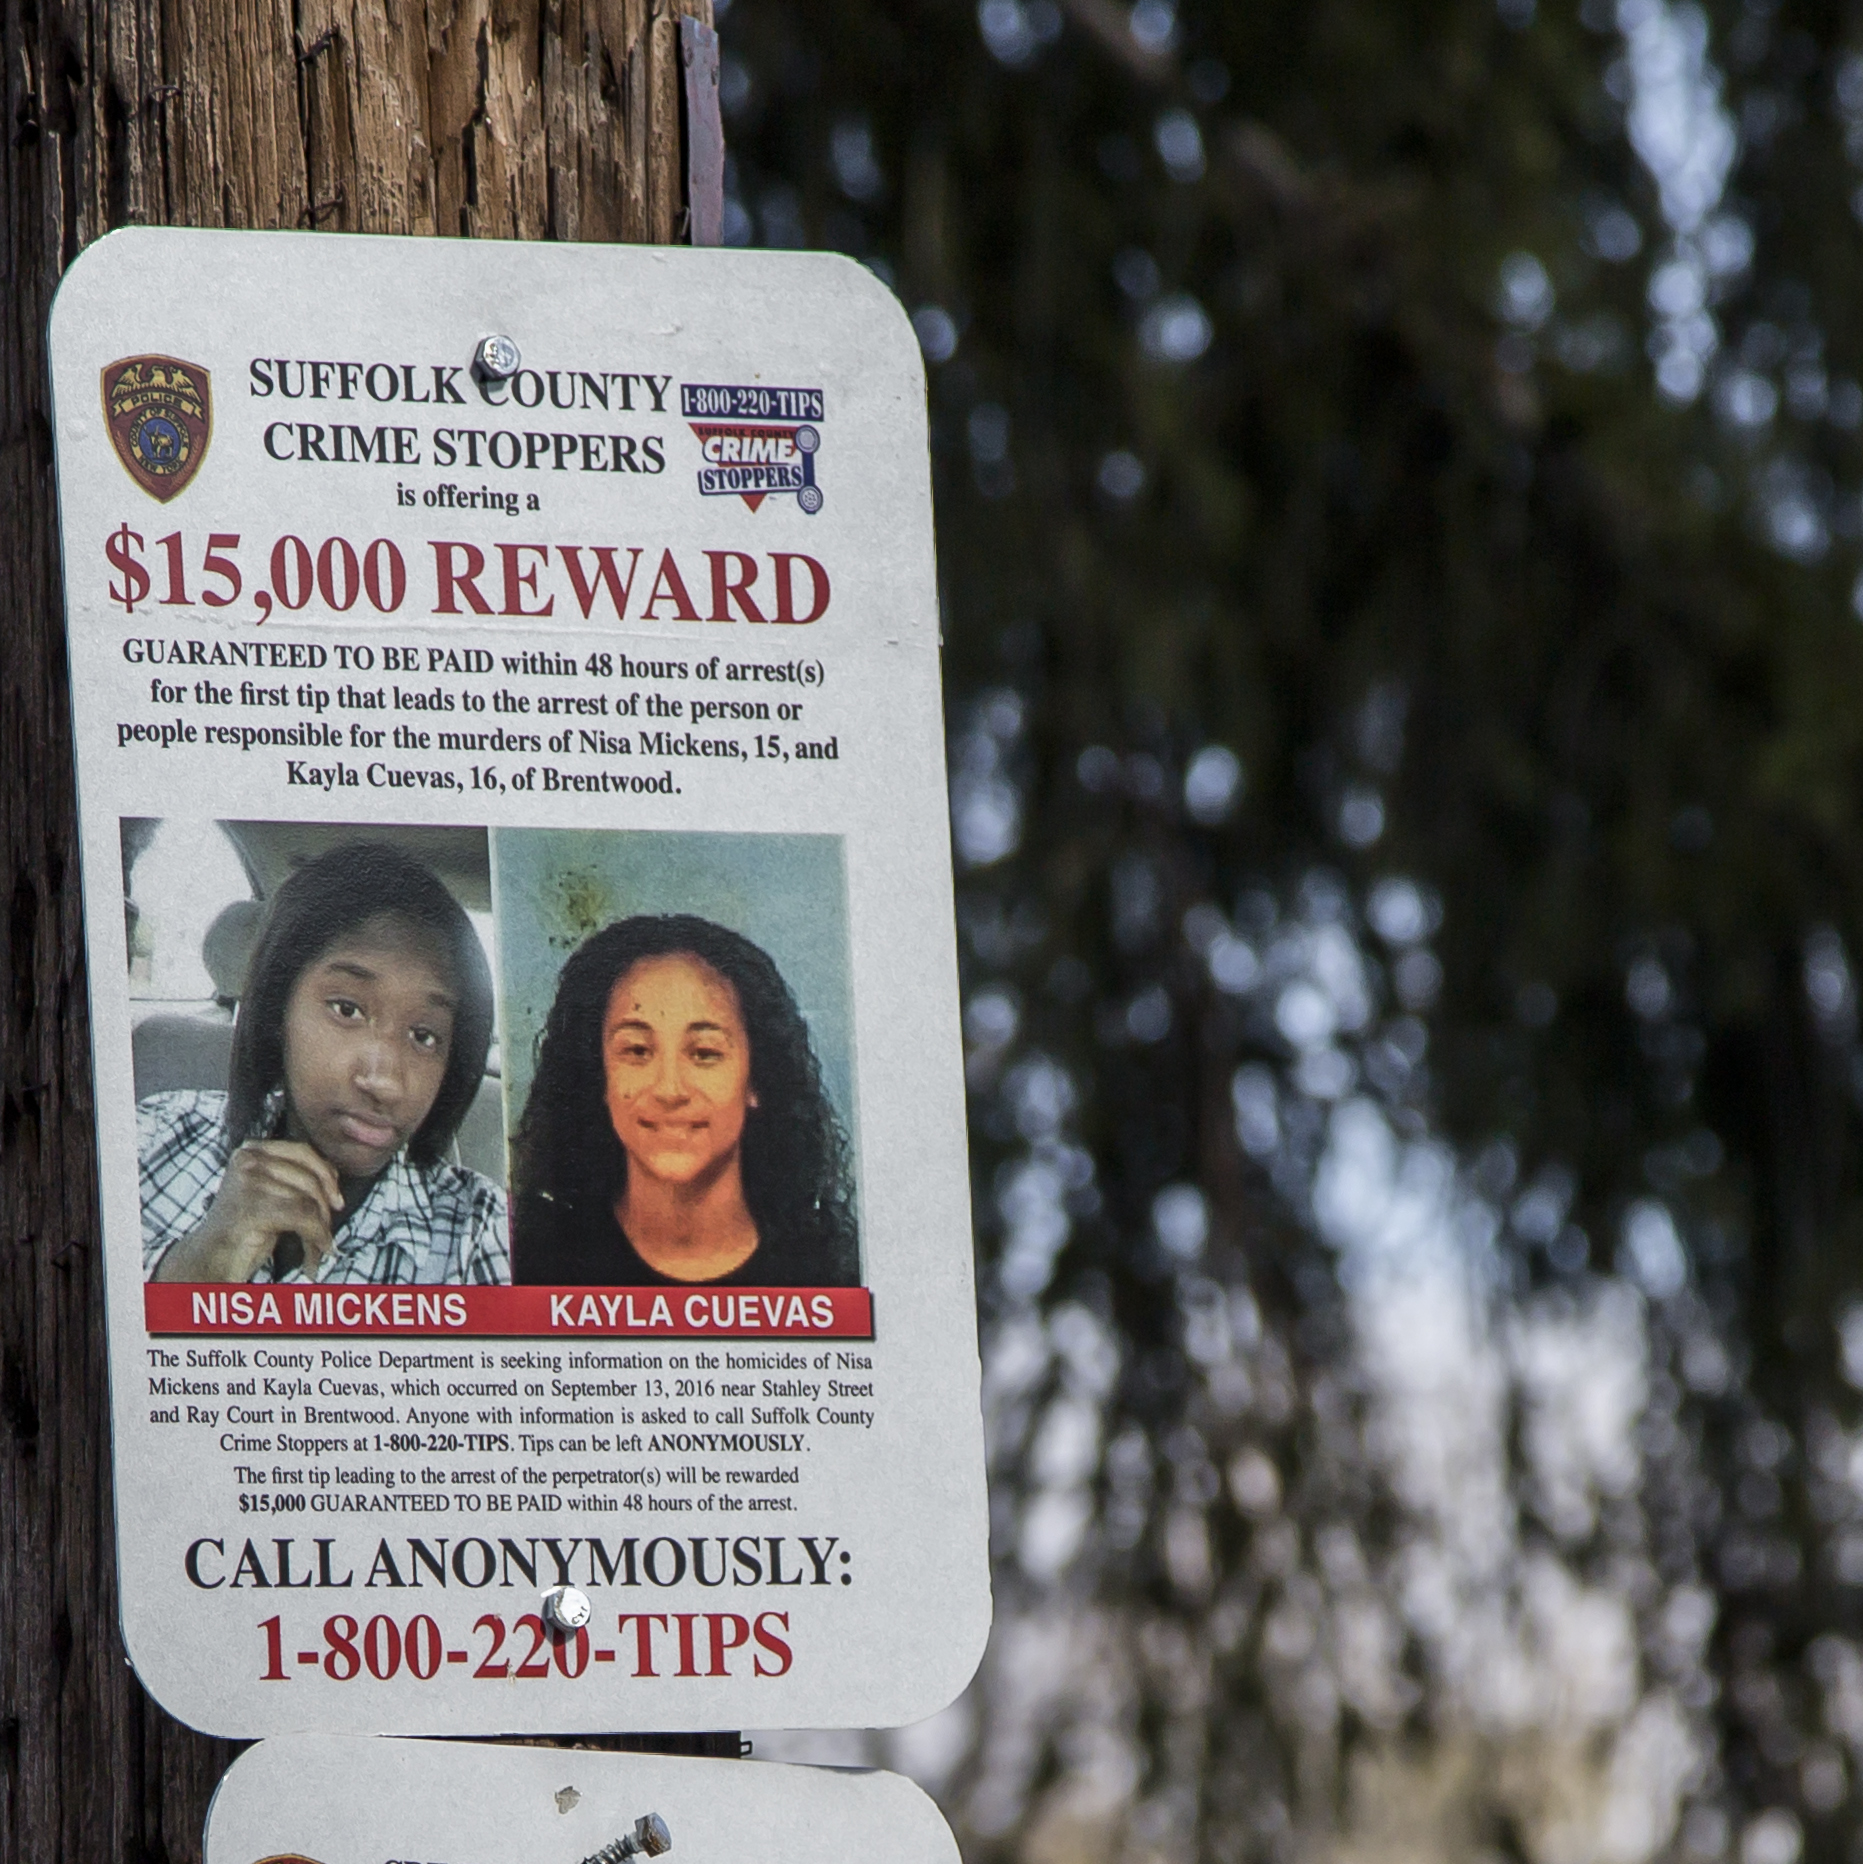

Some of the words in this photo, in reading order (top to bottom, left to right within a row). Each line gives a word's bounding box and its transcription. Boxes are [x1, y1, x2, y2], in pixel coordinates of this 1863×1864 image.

[250, 358, 466, 404] SUFFOLK
[683, 387, 823, 418] 1-800-220-TIPS
[264, 422, 420, 464] CRIME
[434, 428, 665, 474] STOPPERS
[703, 435, 803, 463] CRIME
[702, 465, 804, 490] STOPPERS
[397, 482, 415, 506] is
[423, 484, 519, 516] offering
[527, 494, 540, 510] a
[106, 522, 406, 623] $15,000
[427, 541, 830, 624] REWARD
[123, 639, 327, 668] GUARANTEED
[334, 645, 374, 670] TO
[382, 647, 419, 671] BE
[427, 648, 493, 672] PAID
[502, 651, 577, 675] within
[585, 653, 612, 677] 48
[620, 654, 688, 679] hours
[696, 656, 720, 680] of
[726, 660, 824, 687] arrest(s)
[117, 719, 197, 748] people
[205, 722, 342, 751] responsible
[350, 724, 386, 747] for
[393, 725, 430, 749] the
[438, 728, 541, 752] murders
[549, 729, 573, 752] of
[579, 730, 631, 754] Nisa
[639, 732, 747, 762] Mickens,
[755, 735, 789, 763] 15,
[796, 736, 838, 759] and
[286, 761, 359, 791] Kayla
[367, 763, 463, 793] Cuevas,
[471, 766, 505, 794] 16,
[512, 767, 536, 790] of
[542, 768, 681, 794] Brentwood.
[193, 1292, 281, 1324] NISA
[295, 1293, 466, 1325] MICKENS
[551, 1295, 673, 1326] KAYLA
[685, 1295, 833, 1327] CUEVAS
[147, 1350, 179, 1367] The
[187, 1350, 247, 1367] Suffolk
[254, 1350, 313, 1372] County
[321, 1351, 371, 1368] Police
[379, 1351, 474, 1373] Department
[481, 1352, 494, 1368] is
[501, 1352, 562, 1373] seeking
[569, 1351, 662, 1368] information
[669, 1357, 688, 1368] on
[696, 1353, 719, 1369] the
[726, 1352, 807, 1369] homicides
[814, 1352, 831, 1369] of
[837, 1353, 872, 1369] Nisa
[220, 1434, 271, 1451] Crime
[277, 1434, 348, 1456] Stoppers
[354, 1438, 368, 1451] at
[374, 1434, 514, 1451] 1-800-220-TIPS.
[518, 1435, 554, 1456] Tips
[559, 1440, 586, 1451] can
[592, 1435, 610, 1451] be
[616, 1434, 642, 1451] left
[648, 1434, 810, 1451] ANONYMOUSLY.
[239, 1493, 306, 1515] $15,000
[311, 1494, 449, 1512] GUARANTEED
[454, 1494, 481, 1511] TO
[487, 1495, 512, 1511] BE
[518, 1494, 562, 1511] PAID
[568, 1494, 618, 1511] within
[623, 1494, 643, 1511] 48
[649, 1495, 692, 1511] hours
[698, 1494, 715, 1511] of
[719, 1494, 742, 1510] the
[749, 1497, 797, 1510] arrest.
[185, 1538, 353, 1589] CALL
[364, 1537, 851, 1588] ANONYMOUSLY:
[256, 1610, 794, 1681] 1-800-220-TIPS
